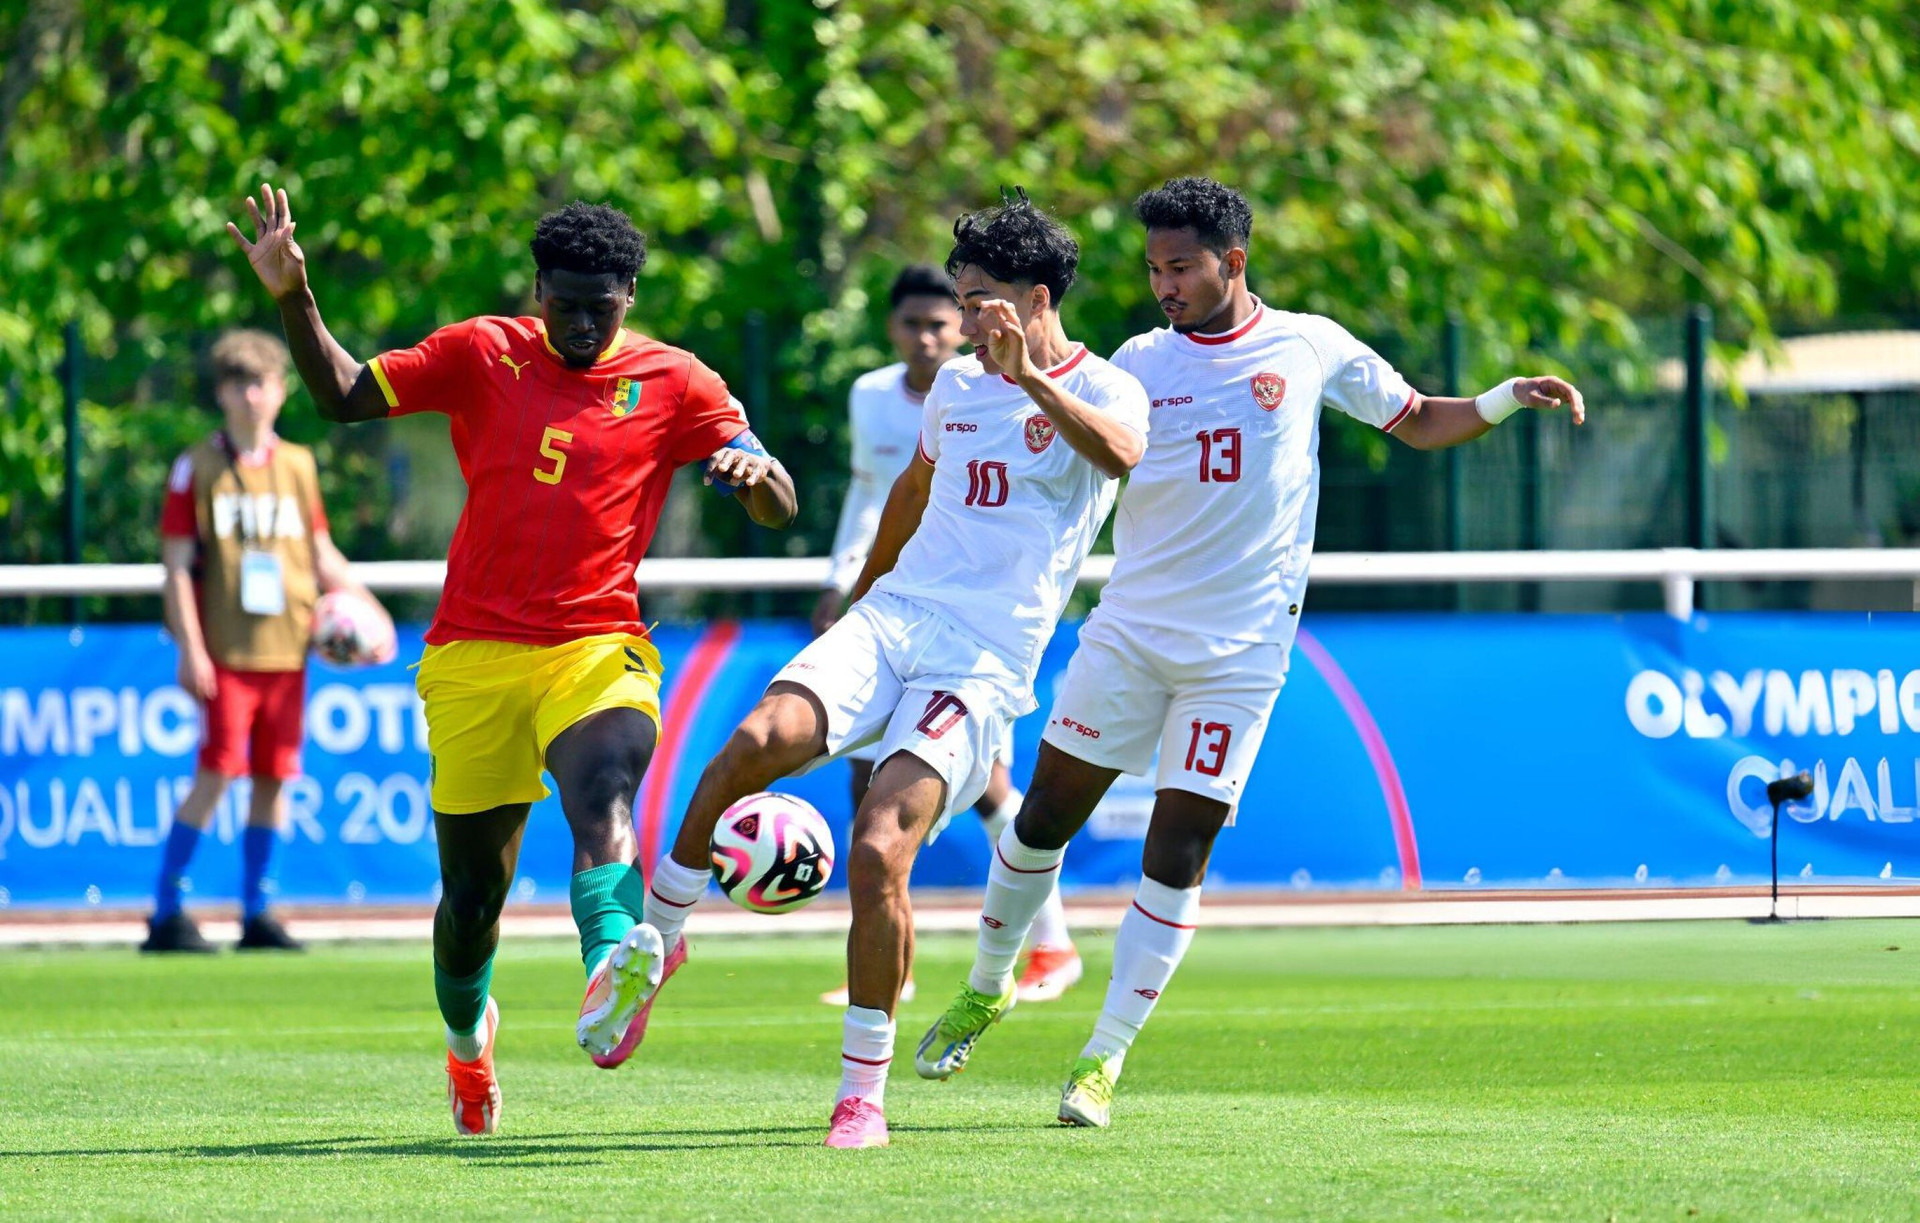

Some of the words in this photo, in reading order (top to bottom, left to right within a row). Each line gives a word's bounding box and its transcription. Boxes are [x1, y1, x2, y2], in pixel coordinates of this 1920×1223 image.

[1152, 395, 1193, 408] erspo
[945, 422, 977, 433] erspo
[533, 426, 573, 485] 5
[1196, 428, 1241, 482] 13
[965, 459, 1009, 507] 10
[913, 690, 968, 740] 10
[1062, 717, 1100, 739] erspo
[1185, 718, 1233, 777] 13
